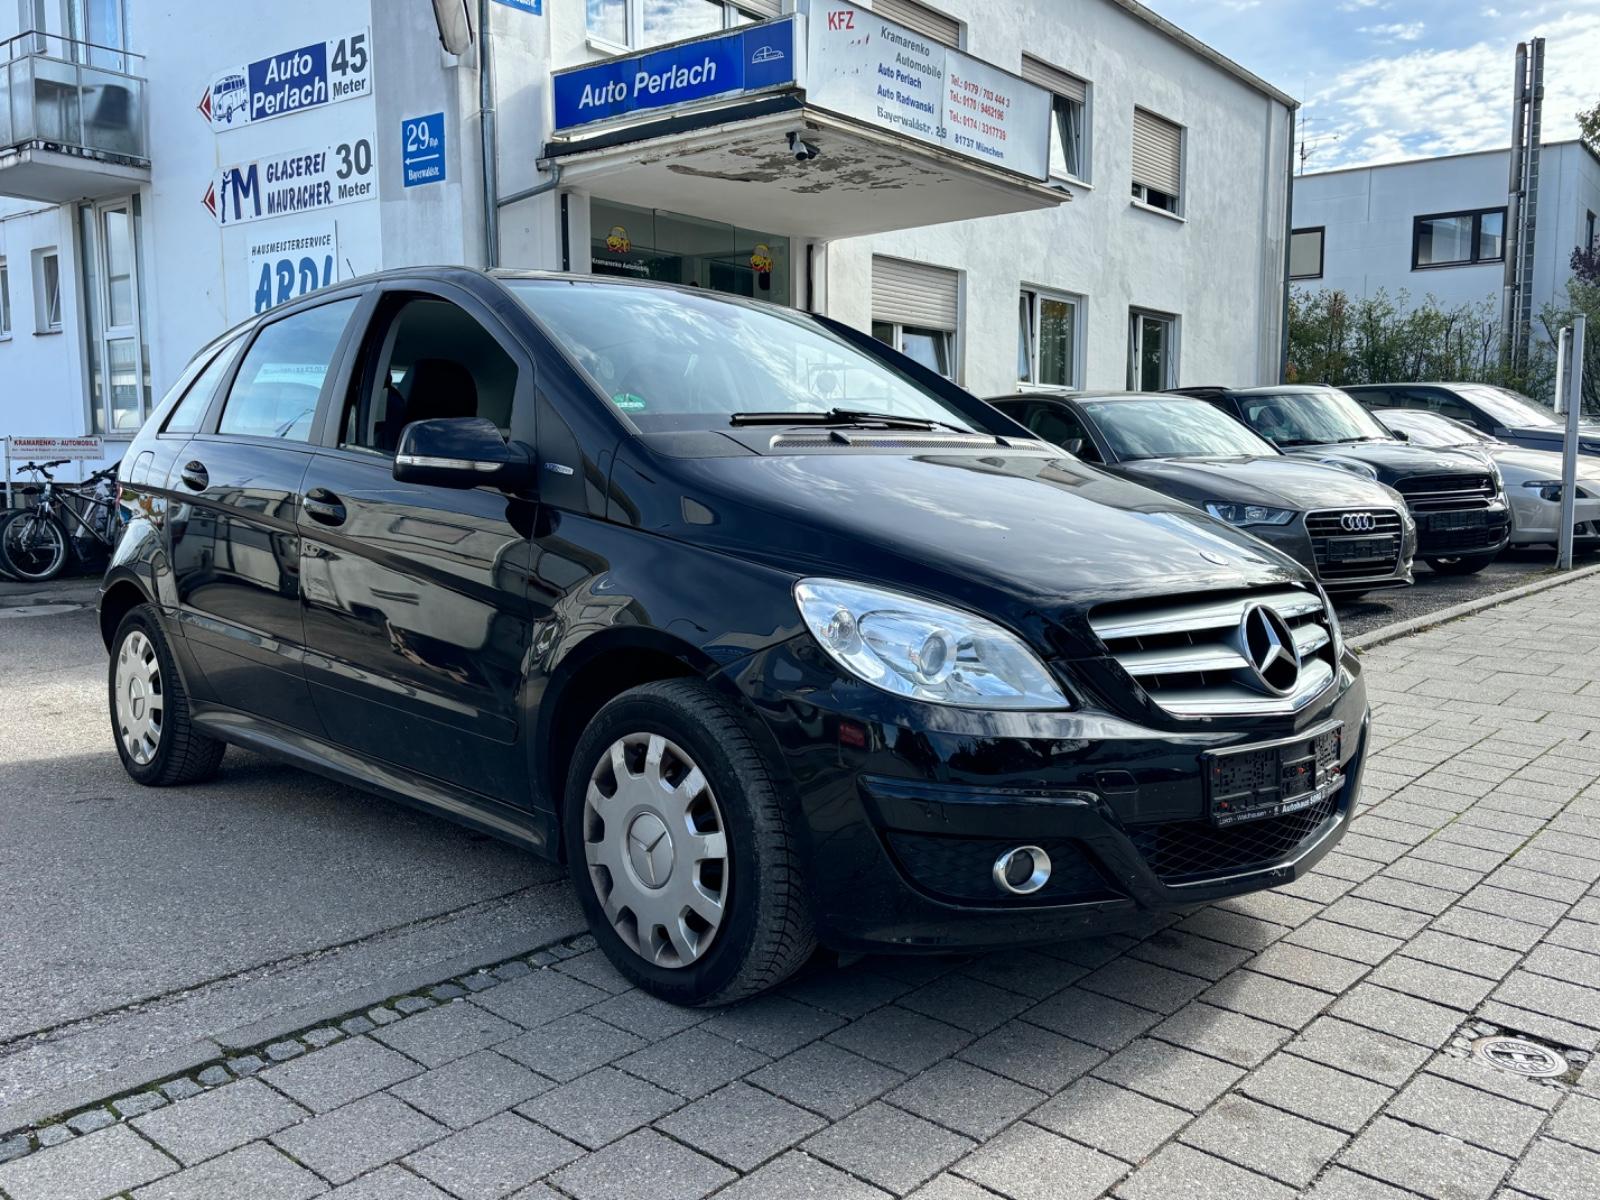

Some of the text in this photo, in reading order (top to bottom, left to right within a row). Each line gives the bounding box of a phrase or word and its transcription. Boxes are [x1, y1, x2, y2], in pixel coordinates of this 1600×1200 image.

[828, 11, 854, 31] KFZ
[331, 34, 368, 76] 45
[881, 26, 930, 56] Kramarenko
[265, 52, 312, 85] Auto
[878, 62, 922, 89] Auto Perlach
[896, 52, 942, 79] Automobile
[252, 76, 326, 118] Perlach
[333, 78, 366, 97] Meter
[578, 57, 717, 109] Auto Perlach
[877, 84, 935, 114] Auto Radwanski
[407, 121, 429, 152] 29
[877, 105, 1004, 159] Bayerwaldstr. 29 81737 München
[267, 152, 326, 183] GLASEREI
[336, 139, 372, 180] 30
[267, 181, 332, 214] MAURACHER
[338, 182, 371, 199] Meter
[252, 234, 331, 256] HAUSMEISTERSERVICE
[14, 439, 56, 447] KRAMARENKO
